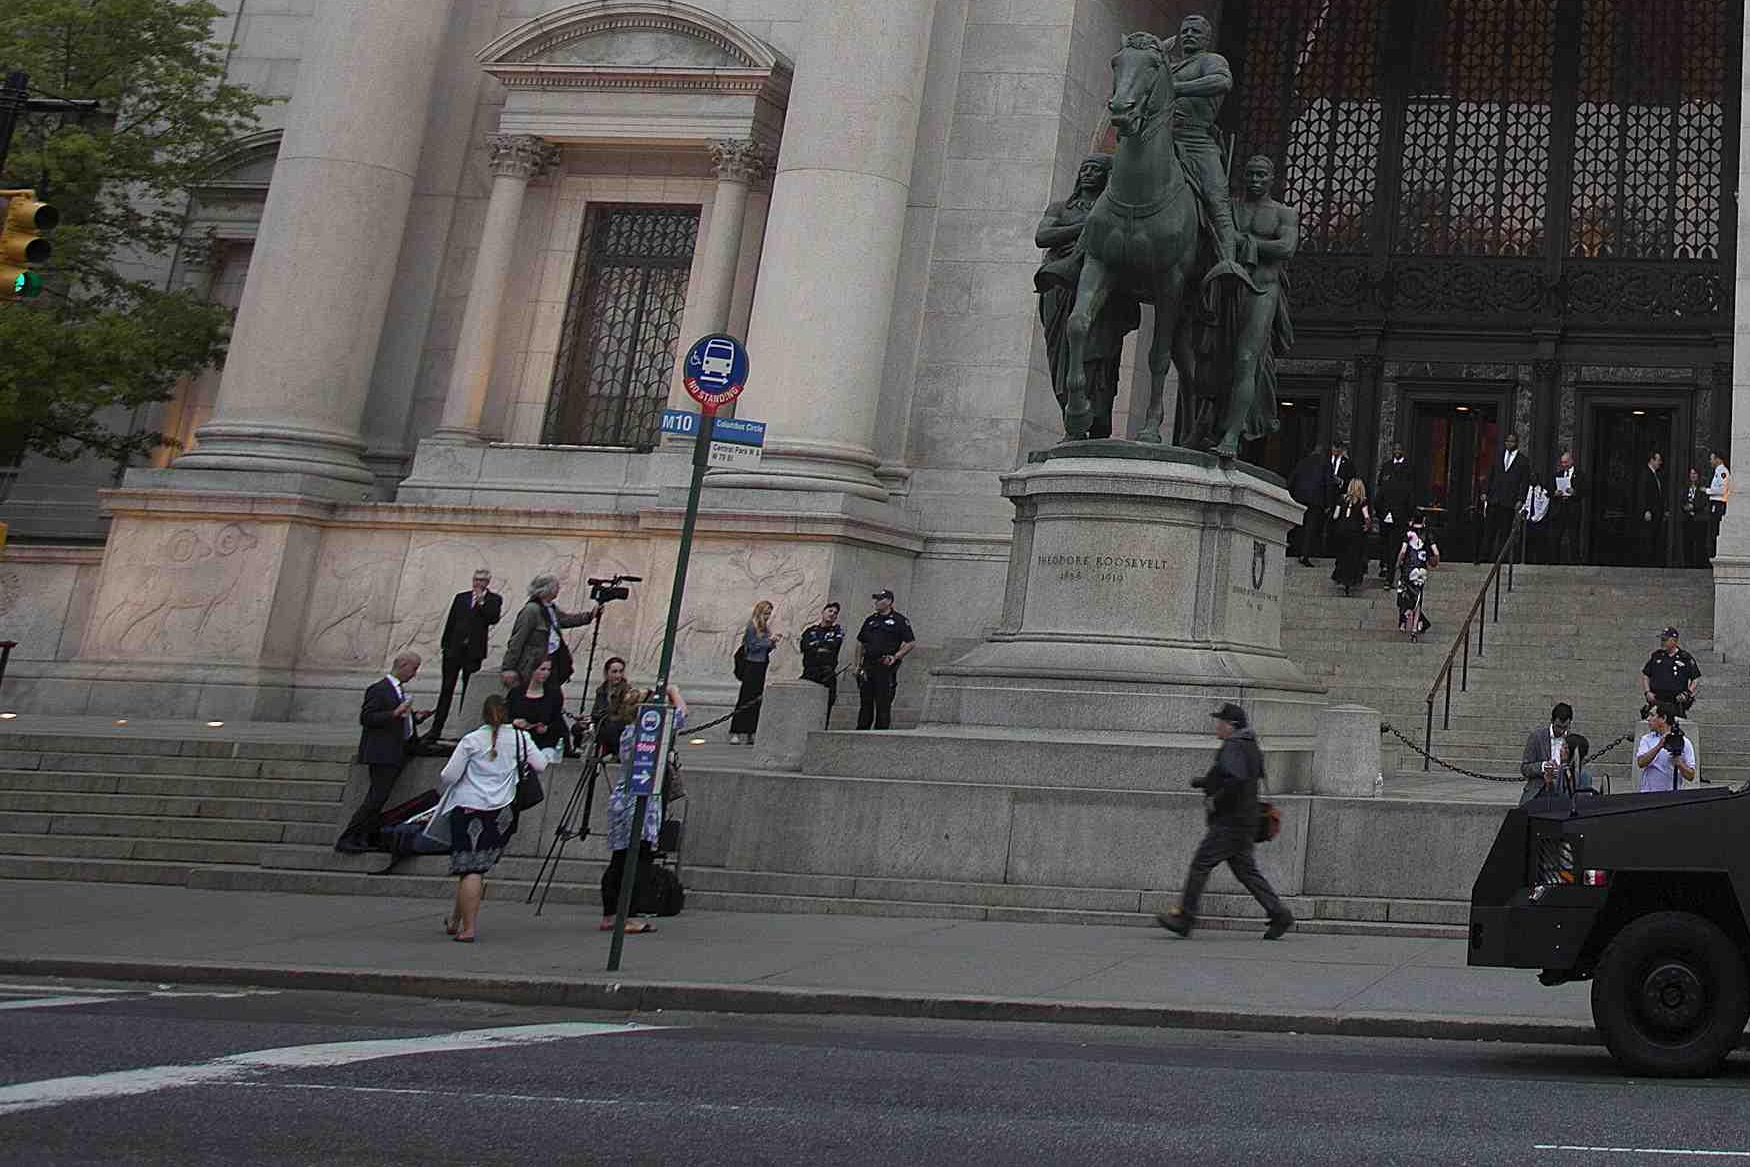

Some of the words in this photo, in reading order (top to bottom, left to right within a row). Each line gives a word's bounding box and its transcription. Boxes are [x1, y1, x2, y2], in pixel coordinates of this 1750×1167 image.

[687, 380, 700, 394] NO
[698, 386, 740, 403] STANDING
[662, 414, 692, 432] M10
[1037, 554, 1089, 567] THEODORE
[1095, 556, 1168, 569] ROOSEVELT
[637, 742, 656, 753] Stop
